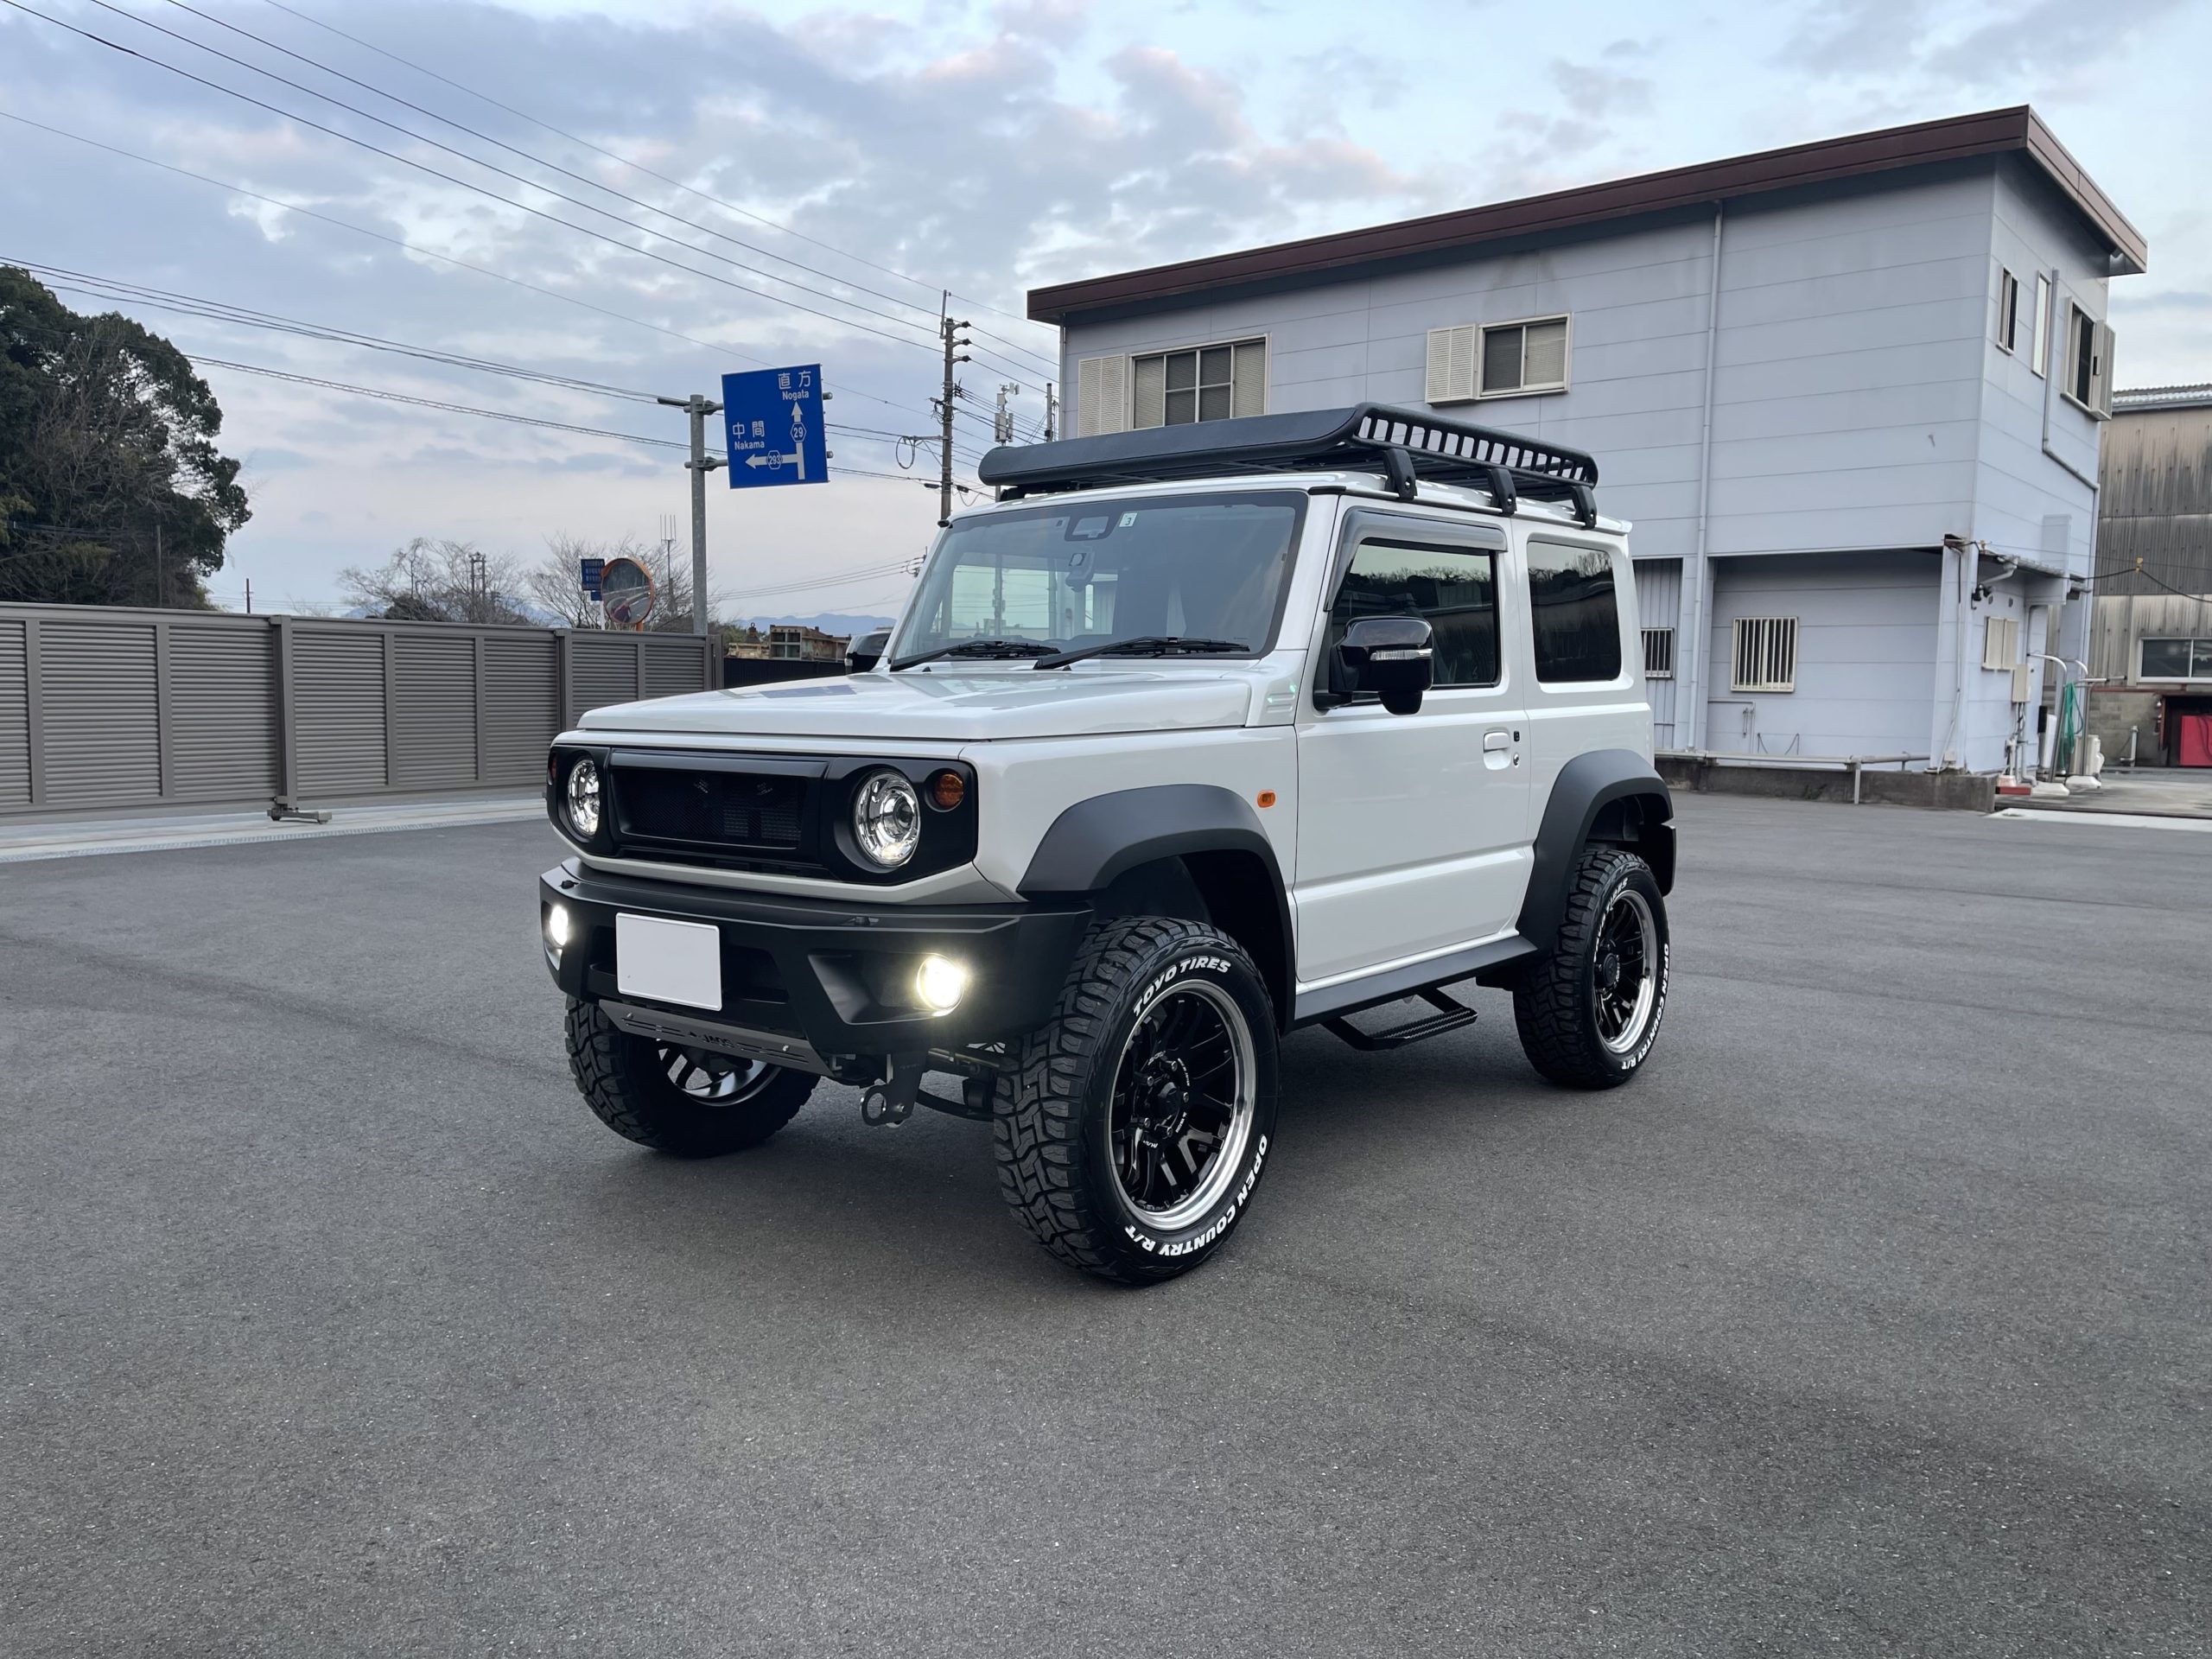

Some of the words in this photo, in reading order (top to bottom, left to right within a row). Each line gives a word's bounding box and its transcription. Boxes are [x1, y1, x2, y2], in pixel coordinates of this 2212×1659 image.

[778, 370, 811, 389] 直方
[782, 390, 810, 400] Nogata
[732, 420, 766, 439] 中間
[793, 427, 804, 438] 29
[734, 441, 766, 450] Nakama
[768, 454, 781, 466] 293
[1133, 963, 1178, 1017] TOYO
[1179, 956, 1232, 974] TIRES
[1637, 996, 1665, 1063] COUNTRY
[1621, 1057, 1637, 1071] R/T
[1236, 1134, 1268, 1207] OPEN
[1124, 1224, 1156, 1253] R/T
[1158, 1205, 1236, 1256] COUNTRY
